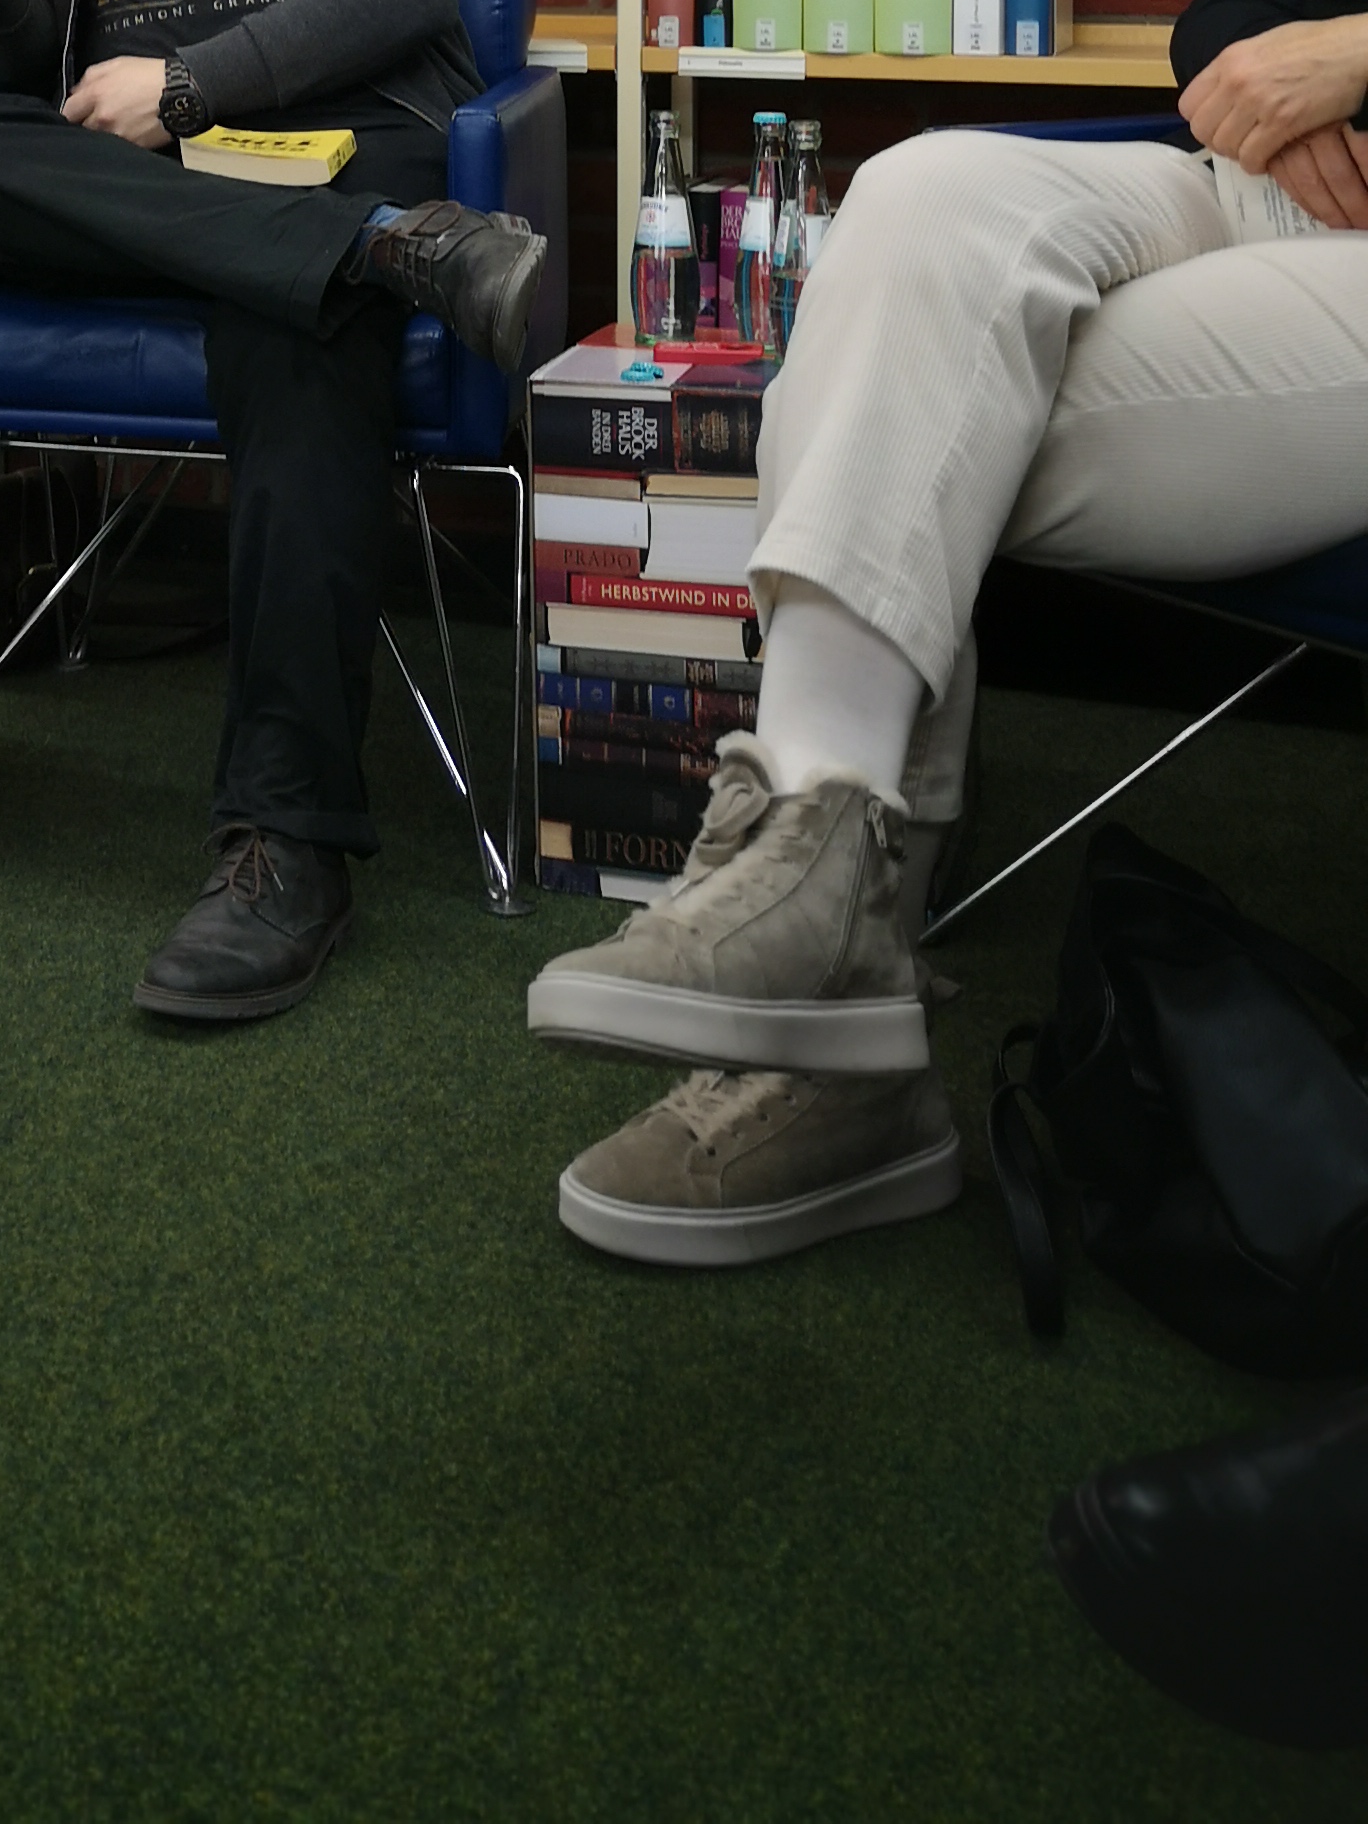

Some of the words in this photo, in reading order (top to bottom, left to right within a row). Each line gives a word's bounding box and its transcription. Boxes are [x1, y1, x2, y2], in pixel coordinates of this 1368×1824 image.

[103, 2, 197, 34] HERMIONE
[601, 411, 612, 425] IN
[618, 410, 633, 456] HAUS
[601, 425, 612, 454] DREI
[631, 406, 646, 461] BROCK
[644, 417, 658, 451] DER
[562, 548, 632, 571] PRADO
[600, 584, 706, 607] HERBSTWIND
[711, 592, 730, 608] IN
